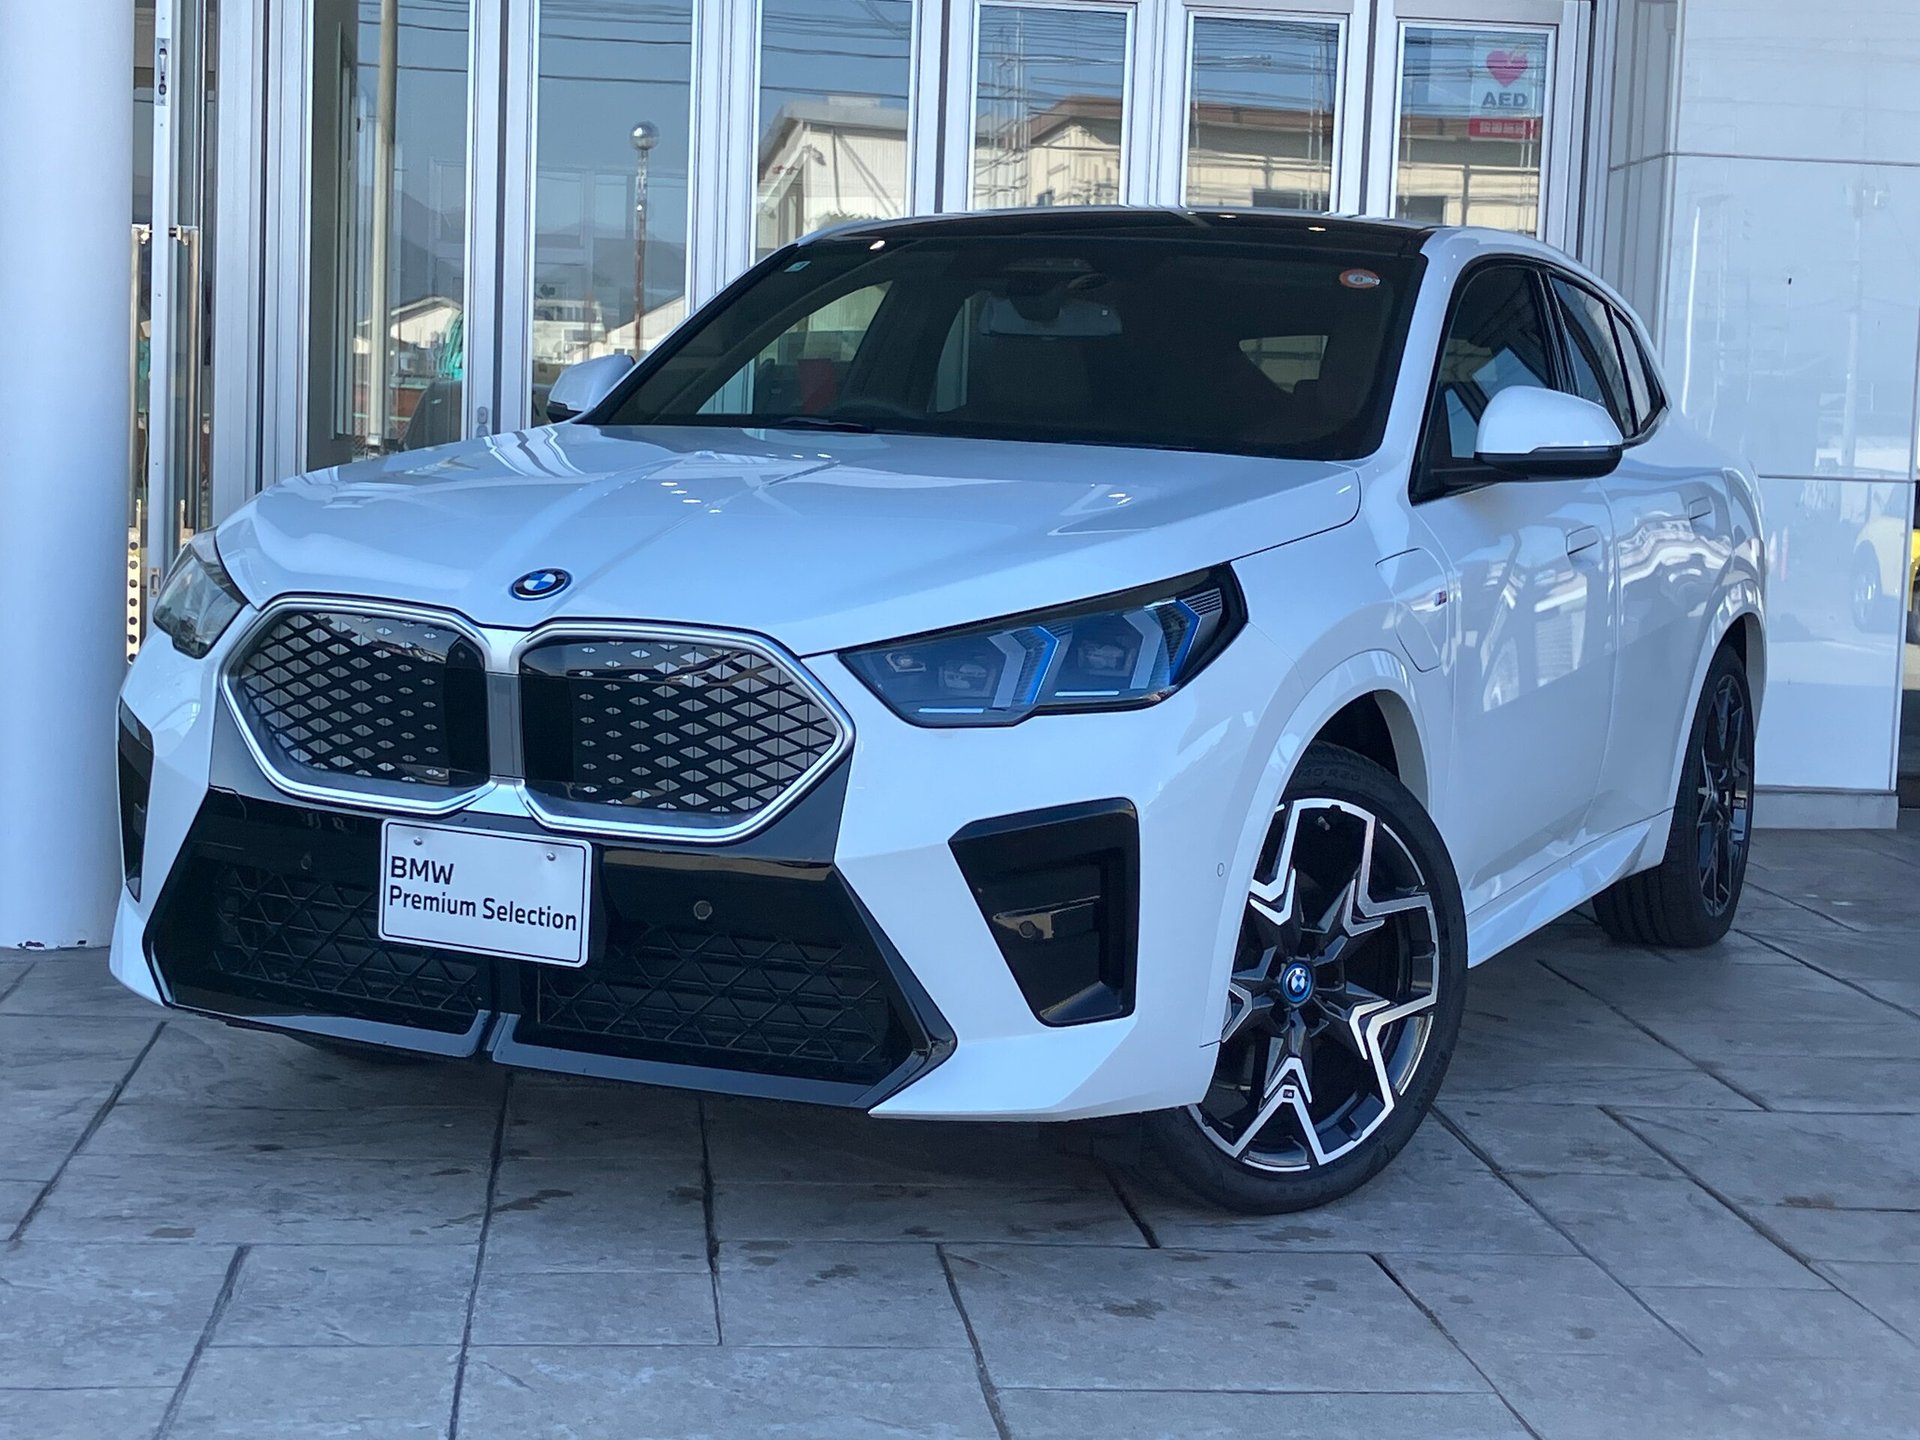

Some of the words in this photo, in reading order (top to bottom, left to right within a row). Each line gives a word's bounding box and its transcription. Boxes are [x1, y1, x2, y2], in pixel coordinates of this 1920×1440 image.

[1481, 91, 1529, 107] AED
[390, 855, 455, 885] BMW
[389, 885, 476, 917] Premium
[482, 897, 577, 931] Selection
